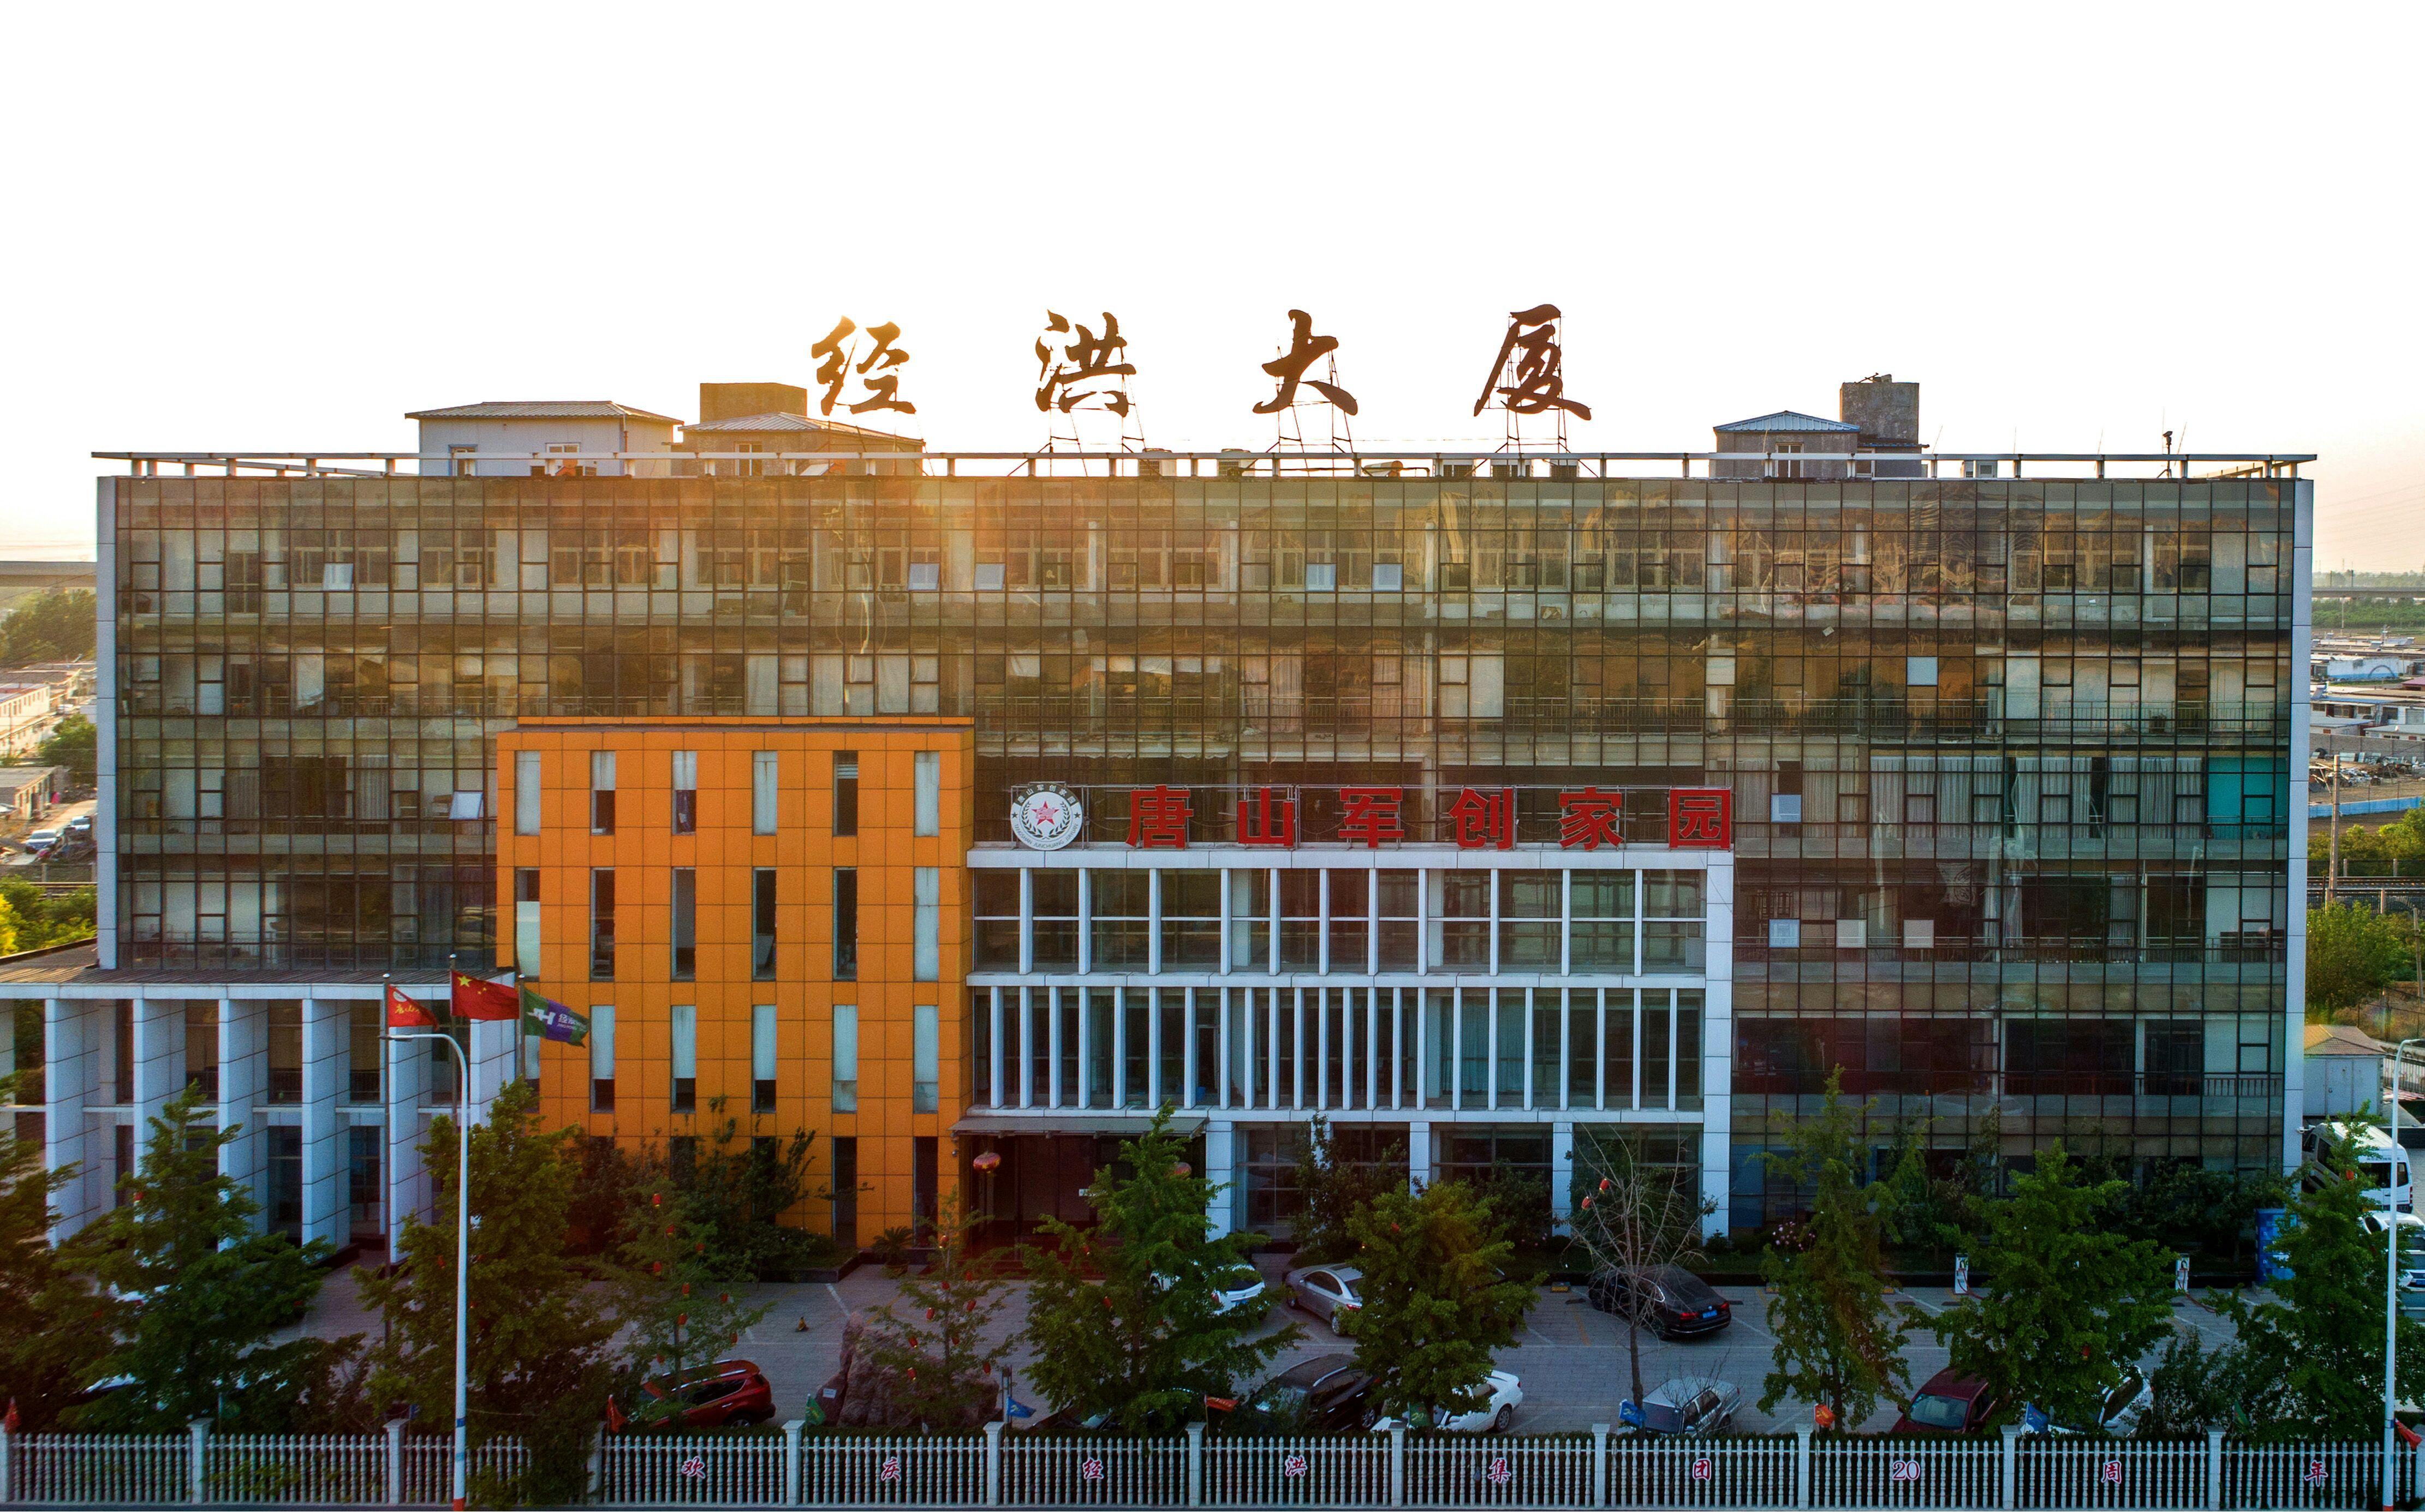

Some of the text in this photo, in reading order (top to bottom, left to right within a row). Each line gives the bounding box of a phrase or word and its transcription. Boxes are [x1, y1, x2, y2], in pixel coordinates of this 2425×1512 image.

[812, 304, 1592, 420] 经洪大厦
[1125, 785, 1732, 851] 唐山军创家园
